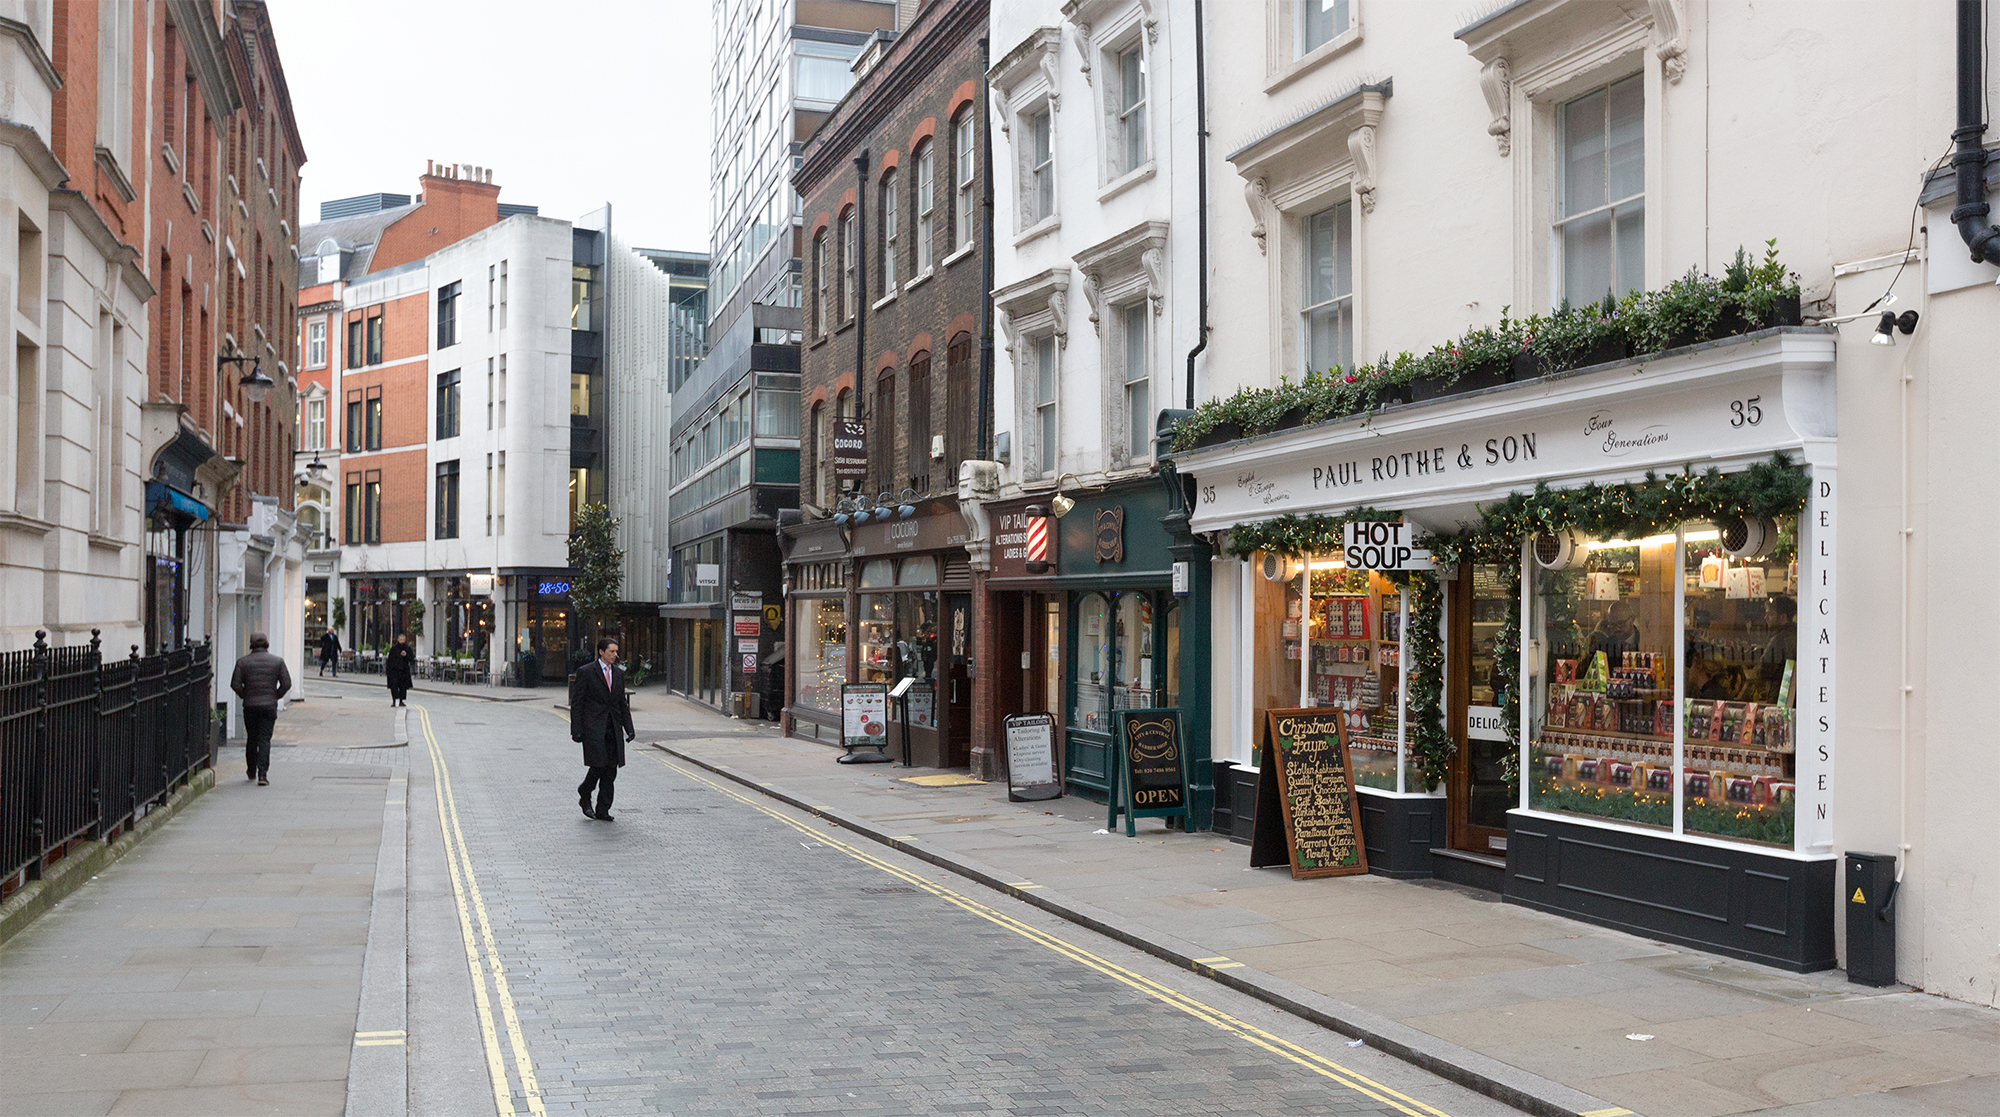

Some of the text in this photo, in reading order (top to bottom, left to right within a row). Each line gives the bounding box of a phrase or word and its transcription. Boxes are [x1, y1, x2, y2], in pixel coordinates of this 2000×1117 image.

[1730, 395, 1763, 429] 35
[845, 423, 865, 435] こころ
[1583, 413, 1613, 436] Four
[834, 438, 863, 449] COCORO
[1602, 430, 1669, 453] Generations
[1313, 432, 1537, 489] PAUL ROTHE & SON
[1203, 485, 1216, 504] 35
[891, 520, 919, 539] COCORO
[999, 513, 1027, 530] VIP TAIL
[995, 533, 1023, 545] ALTERATIONS
[1353, 522, 1403, 546] HOT
[1004, 547, 1018, 559] LADIES
[1346, 546, 1411, 569] SOUP
[1817, 481, 1831, 820] DELICATESSEN
[1279, 716, 1336, 736] Christmas
[1134, 732, 1145, 741] CITY
[1149, 730, 1170, 739] CENTRAL
[1292, 734, 1329, 763] Fayre
[1286, 761, 1314, 776] Stollen
[1288, 774, 1314, 789] Quality
[1135, 788, 1179, 803] OPEN
[1288, 786, 1312, 798] Luxury
[1295, 838, 1327, 849] Marrons
